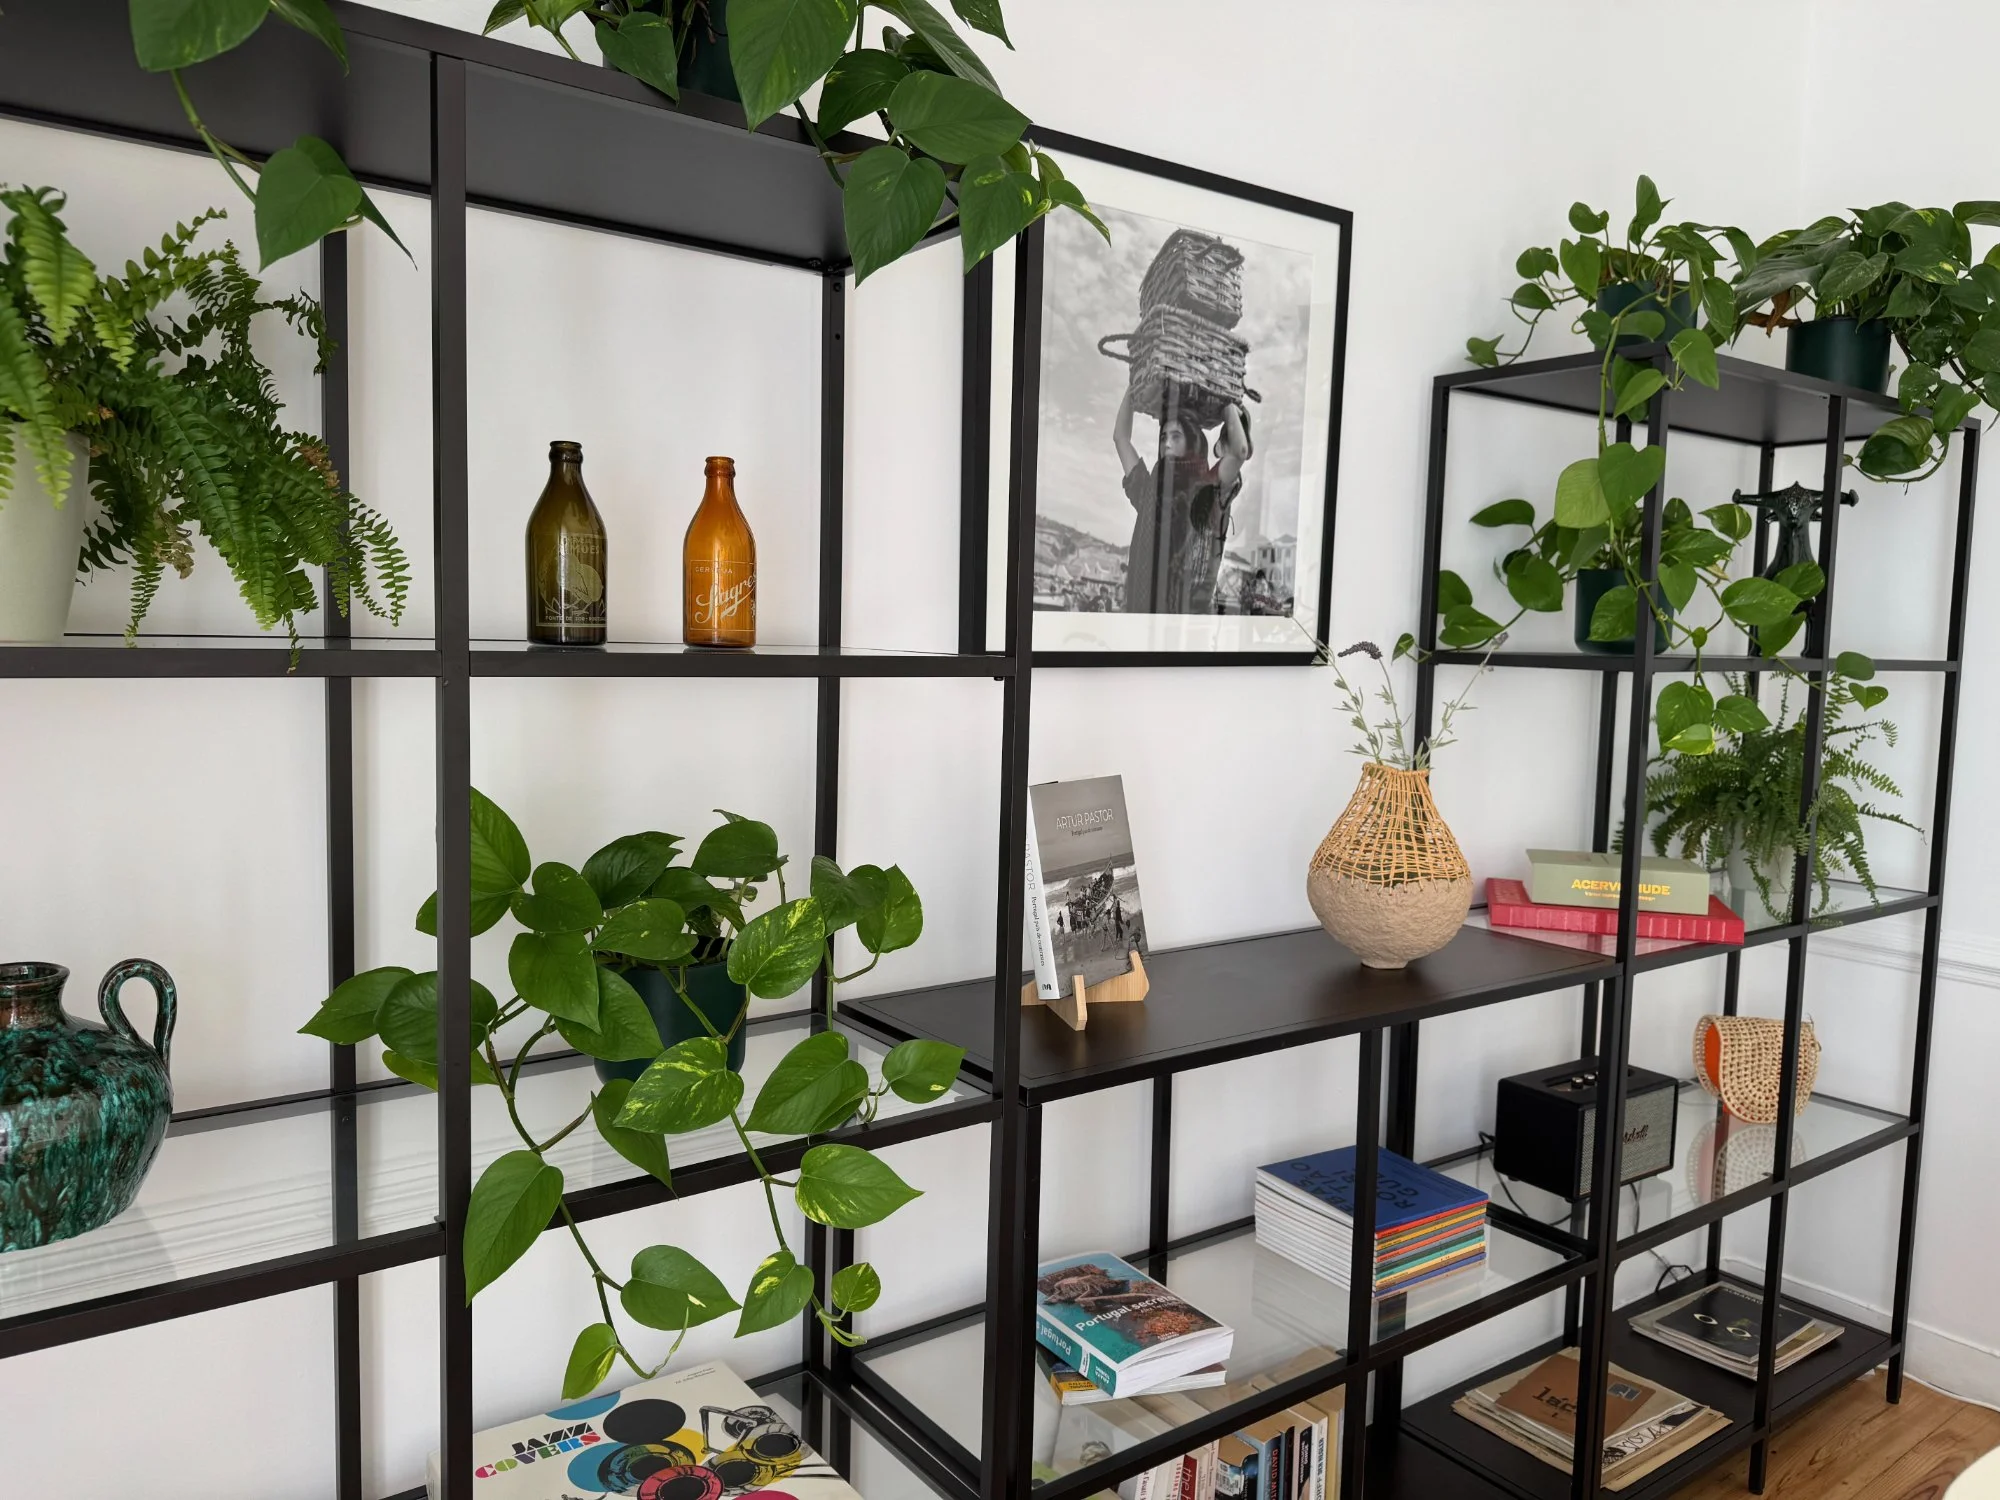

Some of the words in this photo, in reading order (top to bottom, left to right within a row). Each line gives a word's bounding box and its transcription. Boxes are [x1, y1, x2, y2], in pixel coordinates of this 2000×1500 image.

[1056, 813, 1084, 830] ARTUR
[1084, 808, 1114, 826] PASTOR
[1571, 879, 1620, 891] ACERV
[1075, 1305, 1132, 1332] Portugal
[1040, 1324, 1072, 1356] Portugal
[511, 1422, 594, 1456] JAZZ
[475, 1432, 601, 1478] COVERS
[1271, 1448, 1279, 1478] DAVID
[1181, 1467, 1193, 1491] the
[1270, 1481, 1278, 1500] MIT
